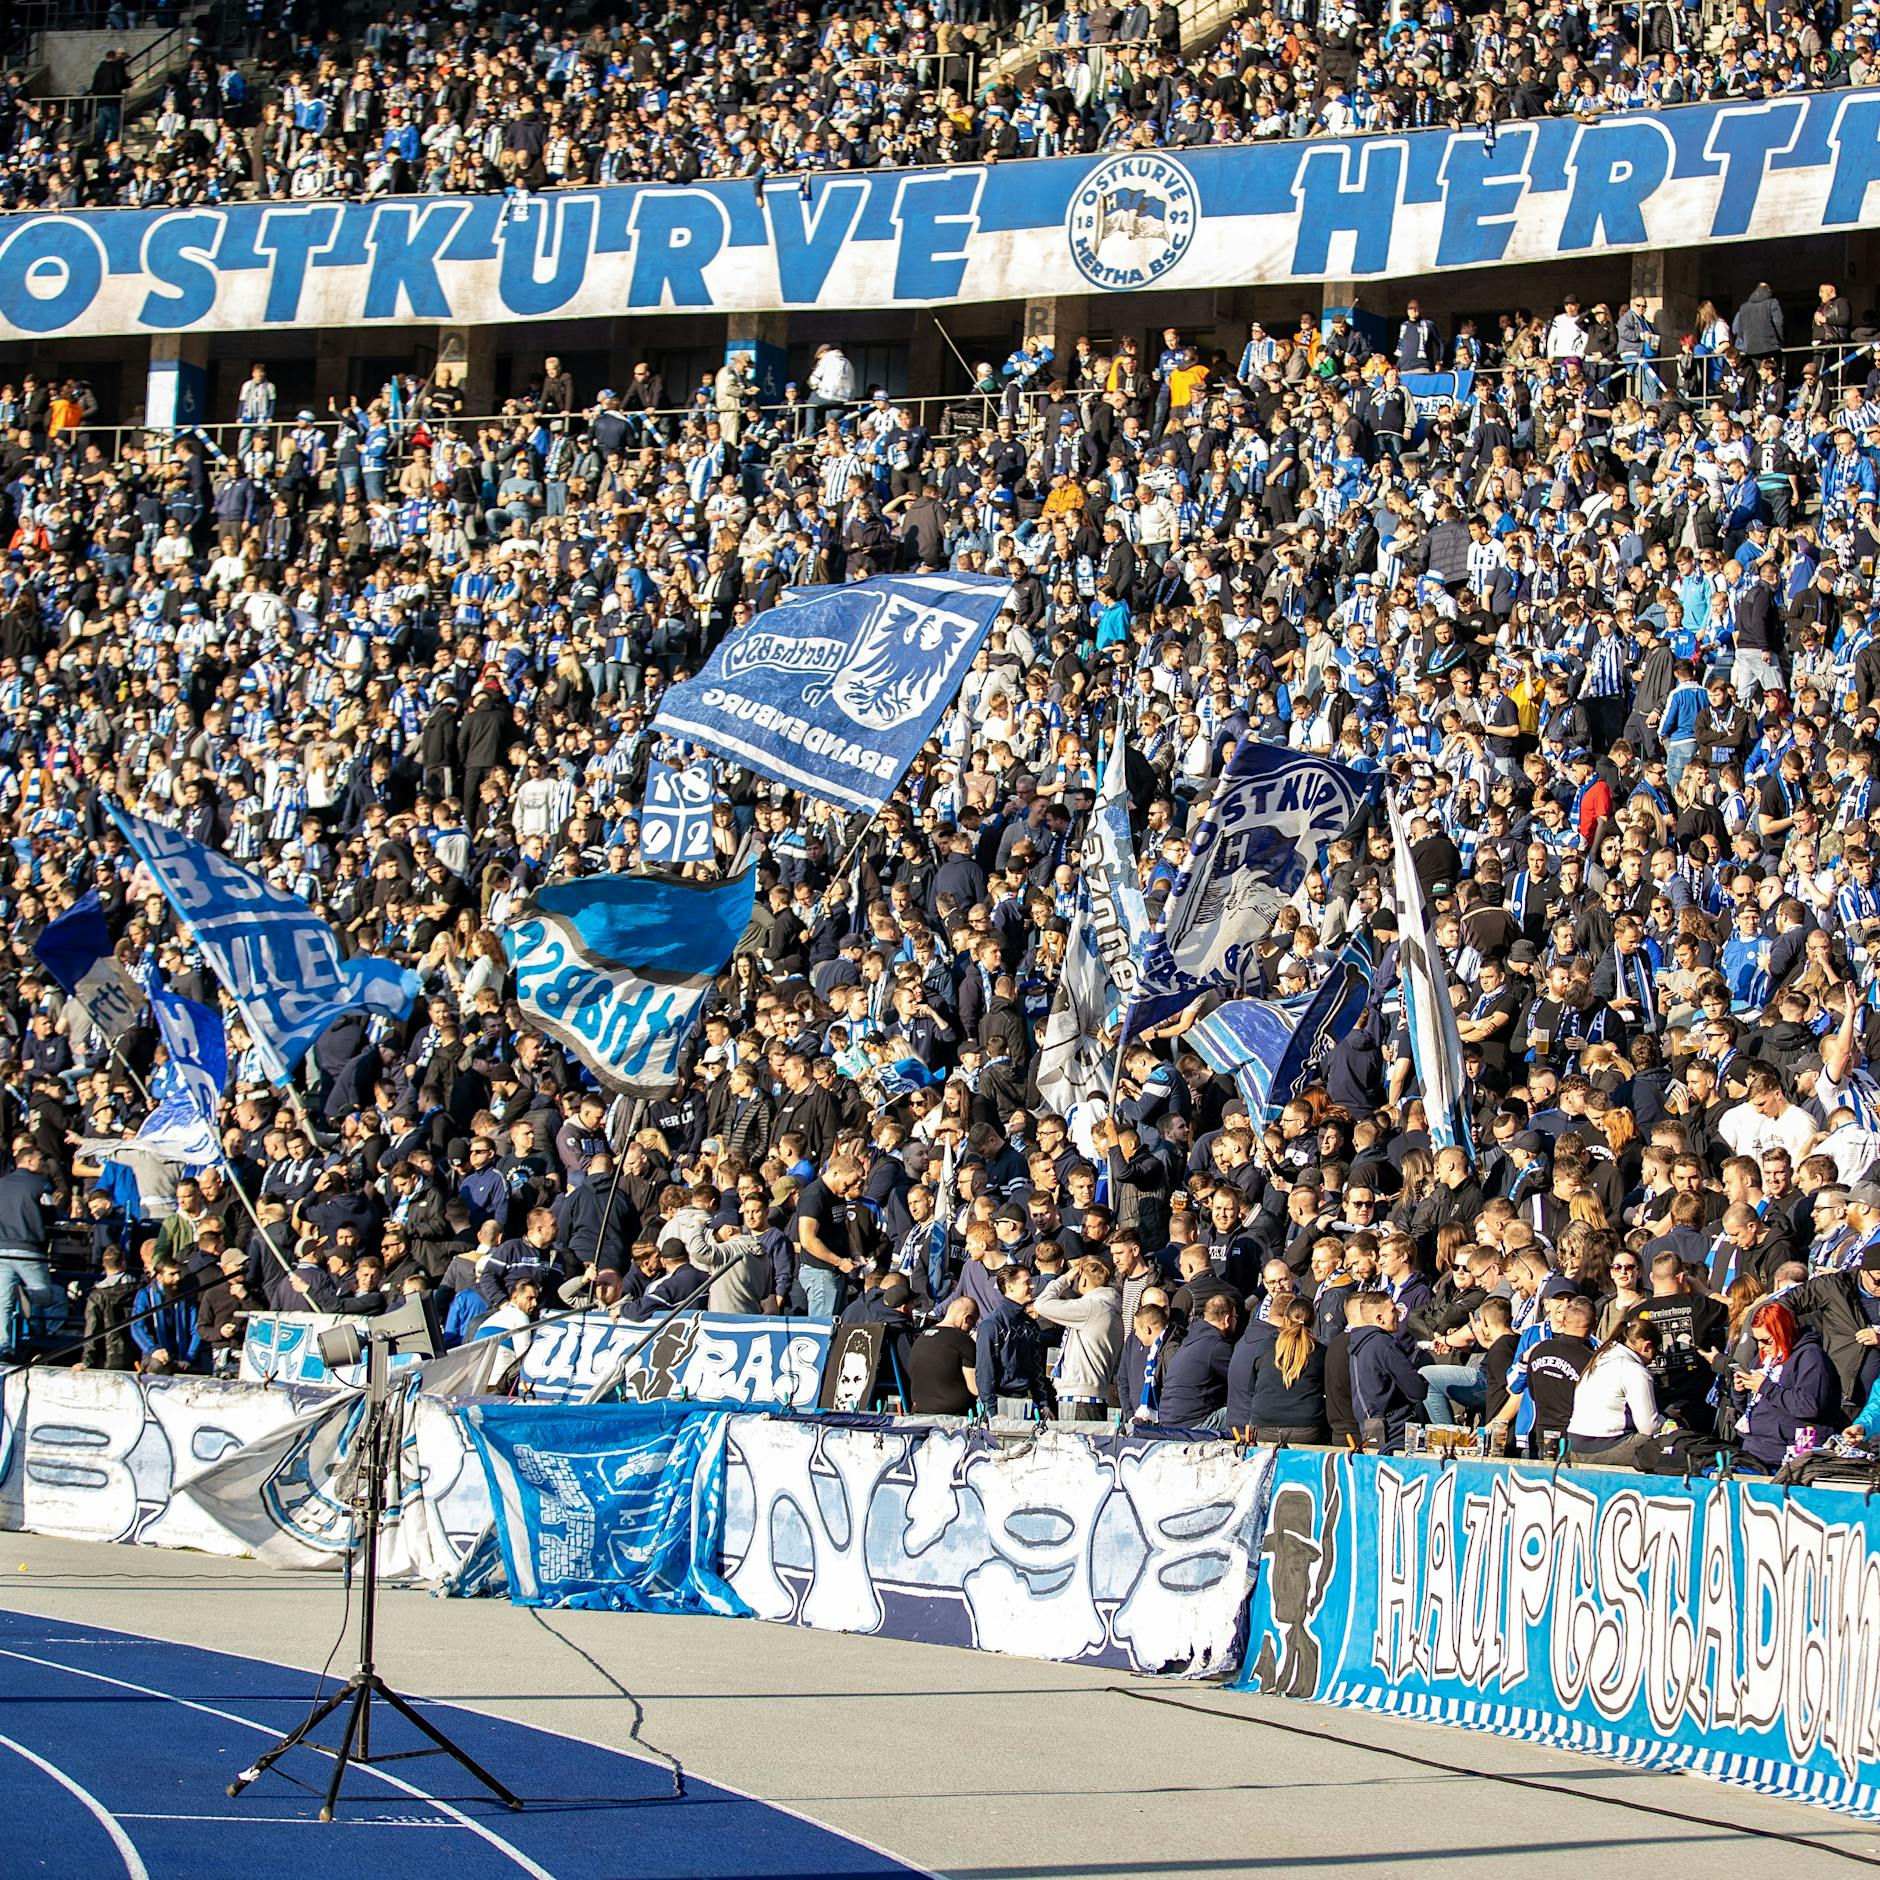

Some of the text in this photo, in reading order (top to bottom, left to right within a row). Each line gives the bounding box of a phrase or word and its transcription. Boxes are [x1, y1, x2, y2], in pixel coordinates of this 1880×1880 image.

[1082, 159, 1187, 206] OSTKURVE
[1076, 216, 1094, 229] 18
[1168, 210, 1189, 225] 92
[0, 165, 988, 334] OSTKURVE
[1075, 233, 1187, 285] HERTHA BSC
[1761, 448, 1773, 469] 6
[262, 600, 272, 621] 7
[653, 767, 712, 802] 18
[642, 818, 709, 856] 92
